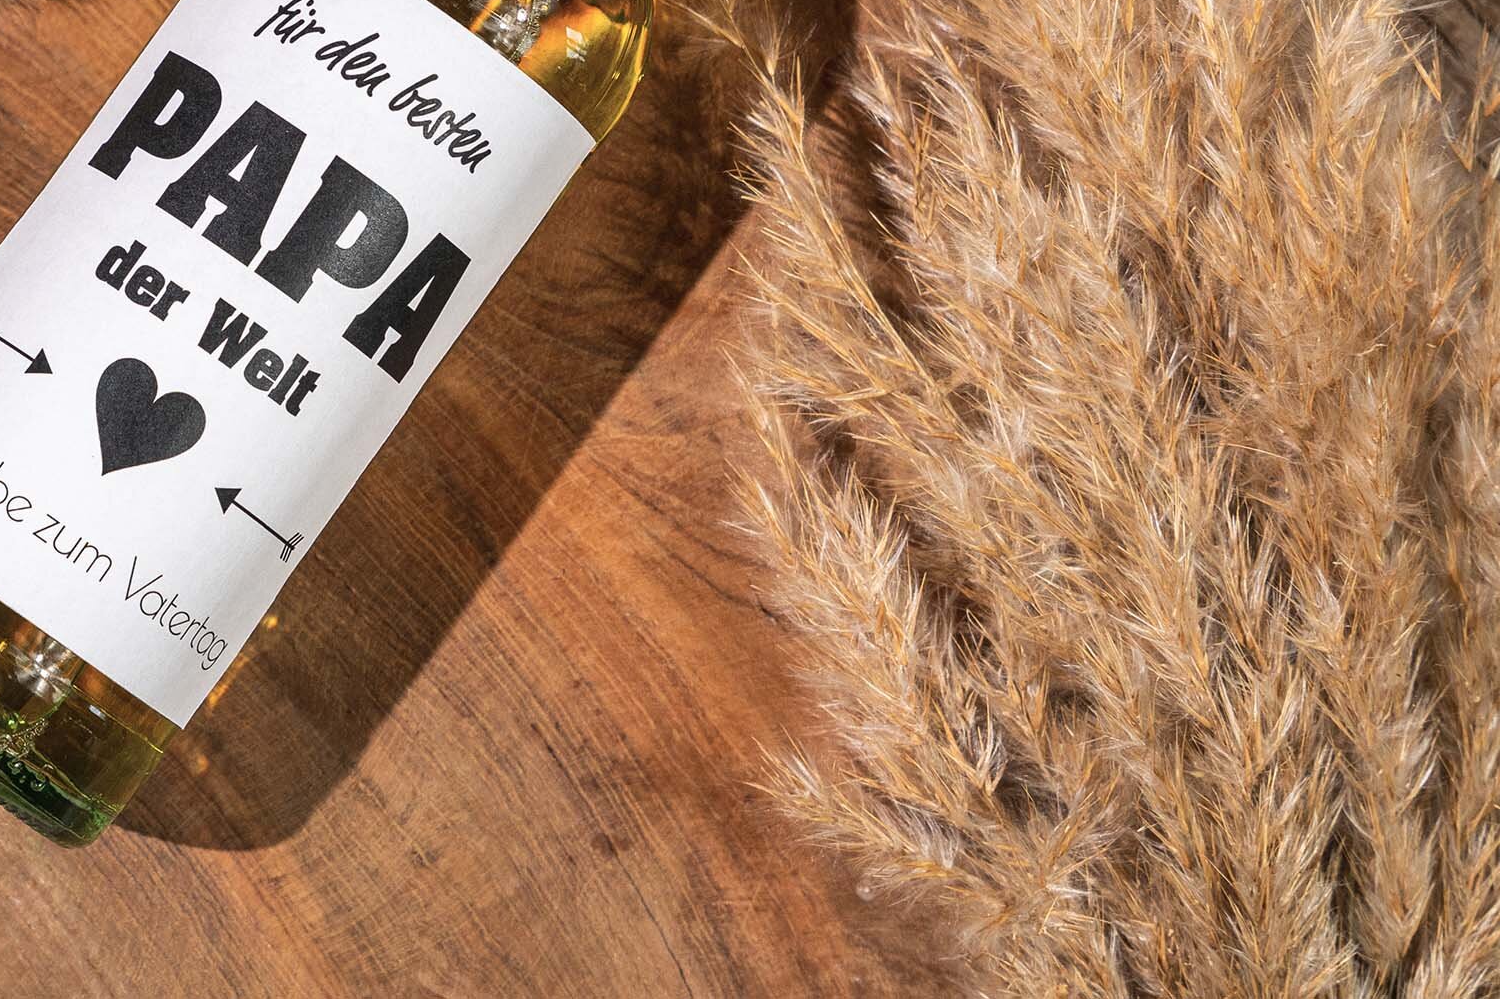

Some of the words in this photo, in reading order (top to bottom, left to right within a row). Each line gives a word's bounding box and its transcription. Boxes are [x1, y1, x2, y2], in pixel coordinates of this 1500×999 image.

[315, 33, 391, 97] den
[389, 74, 492, 173] besten
[88, 51, 471, 383] PAPA
[96, 240, 191, 321] der
[198, 298, 321, 416] Welt
[32, 514, 113, 583] zum
[125, 556, 229, 671] Vatertag
